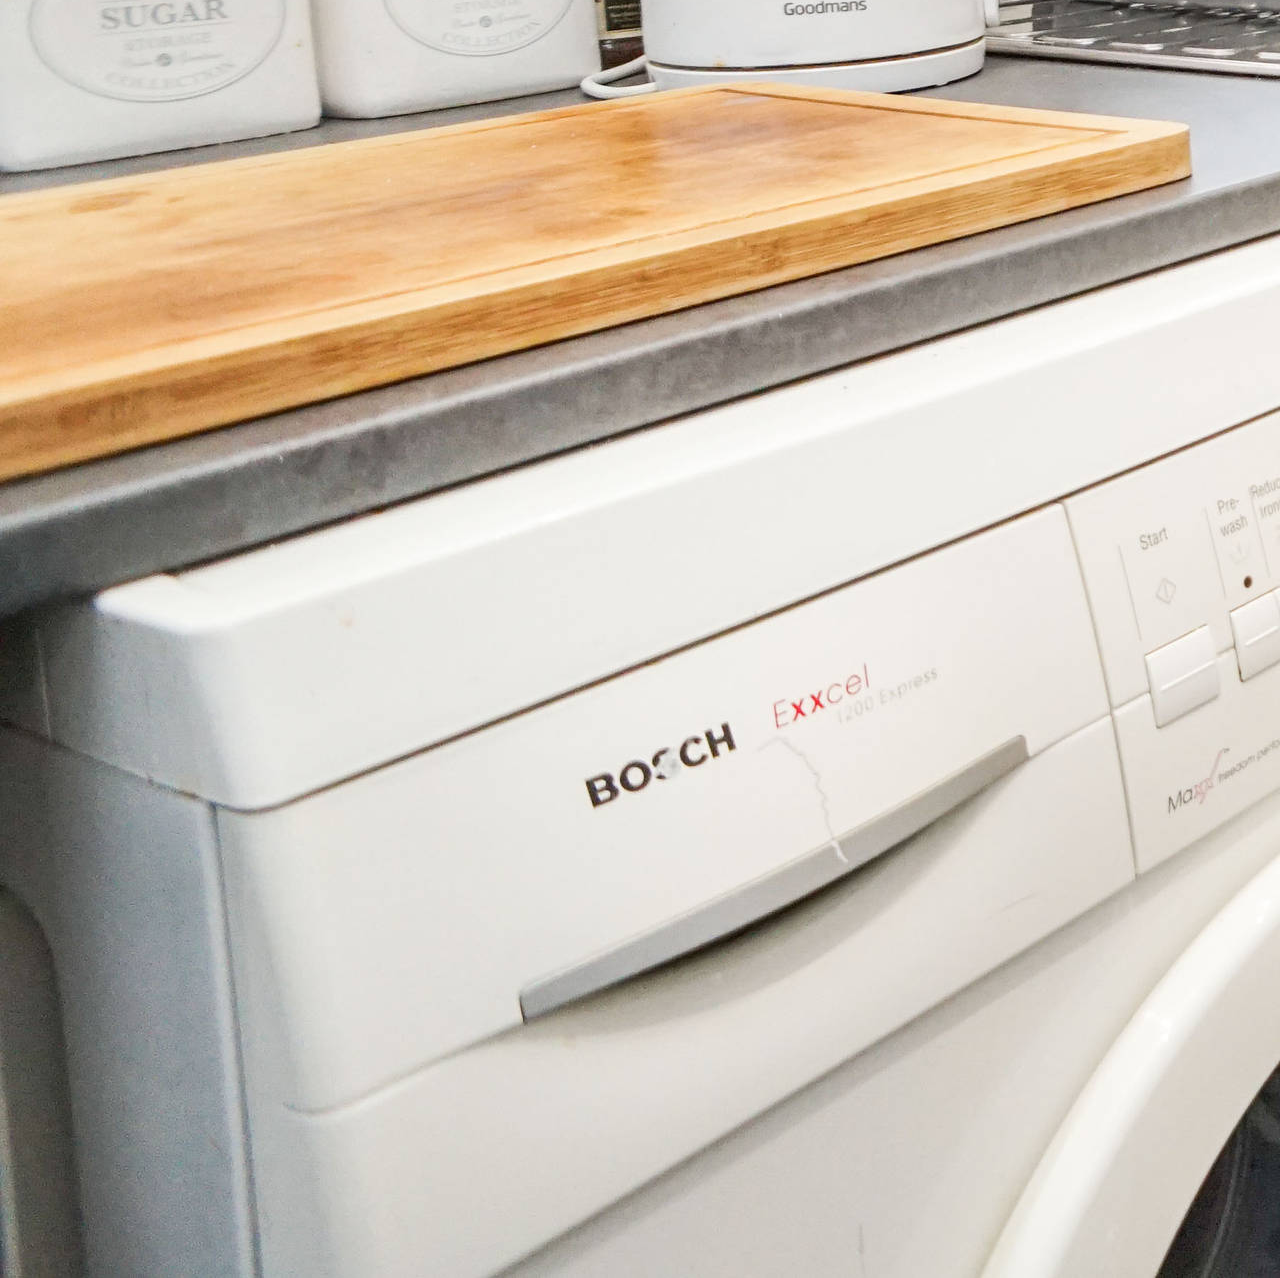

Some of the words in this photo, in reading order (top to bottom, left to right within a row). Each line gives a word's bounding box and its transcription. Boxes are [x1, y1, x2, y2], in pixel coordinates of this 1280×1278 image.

[784, 0, 867, 16] Goodmans
[441, 21, 543, 47] COLLECTION
[1217, 498, 1240, 516] Pre-
[1139, 525, 1169, 551] Start
[1219, 515, 1249, 538] wash
[772, 662, 871, 730] Exxcel
[836, 694, 874, 726] 1200
[879, 667, 938, 707] Express
